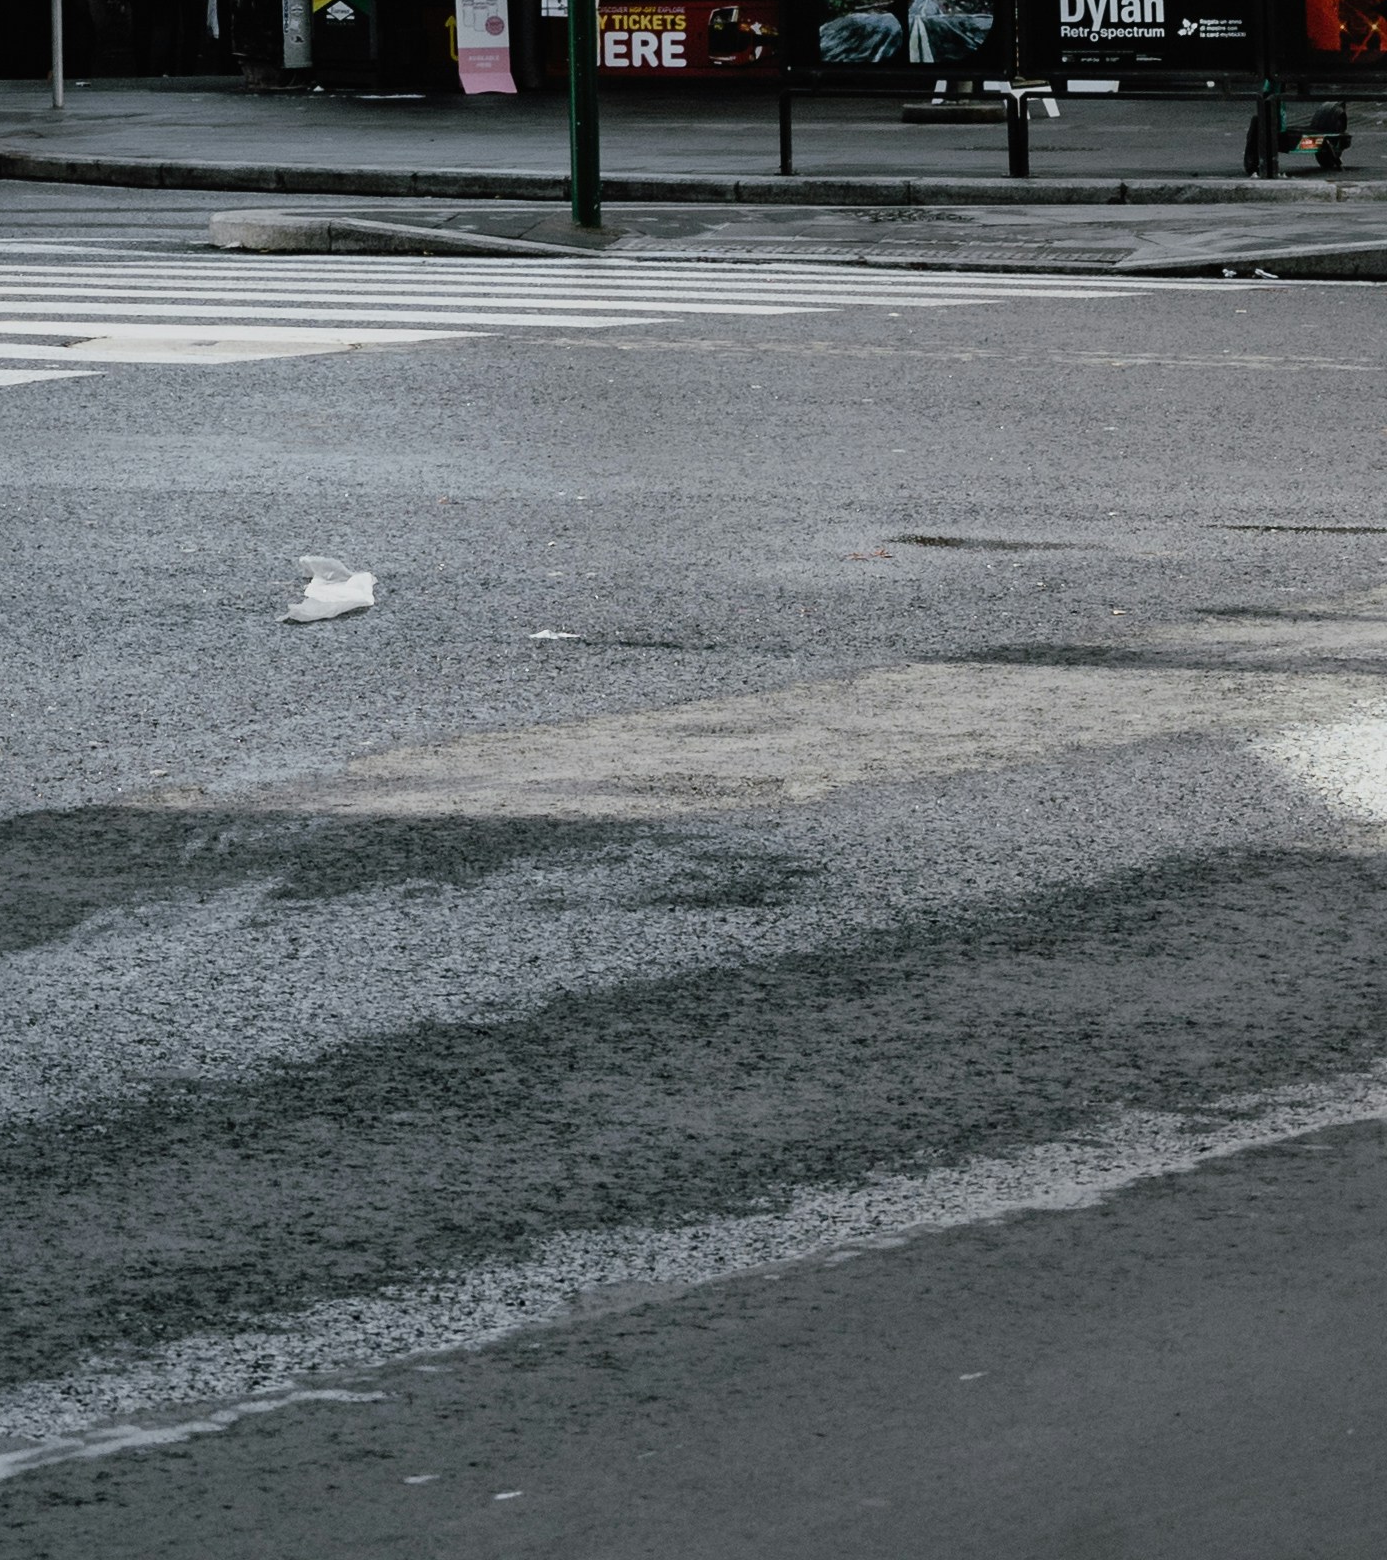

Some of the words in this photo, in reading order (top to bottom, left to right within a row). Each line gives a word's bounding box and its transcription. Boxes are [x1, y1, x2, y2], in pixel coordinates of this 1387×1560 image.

[657, 6, 685, 14] EXPLORE
[612, 14, 687, 31] TICKETS
[1060, 25, 1166, 43] Retrospectrum
[597, 31, 688, 69] ERE
